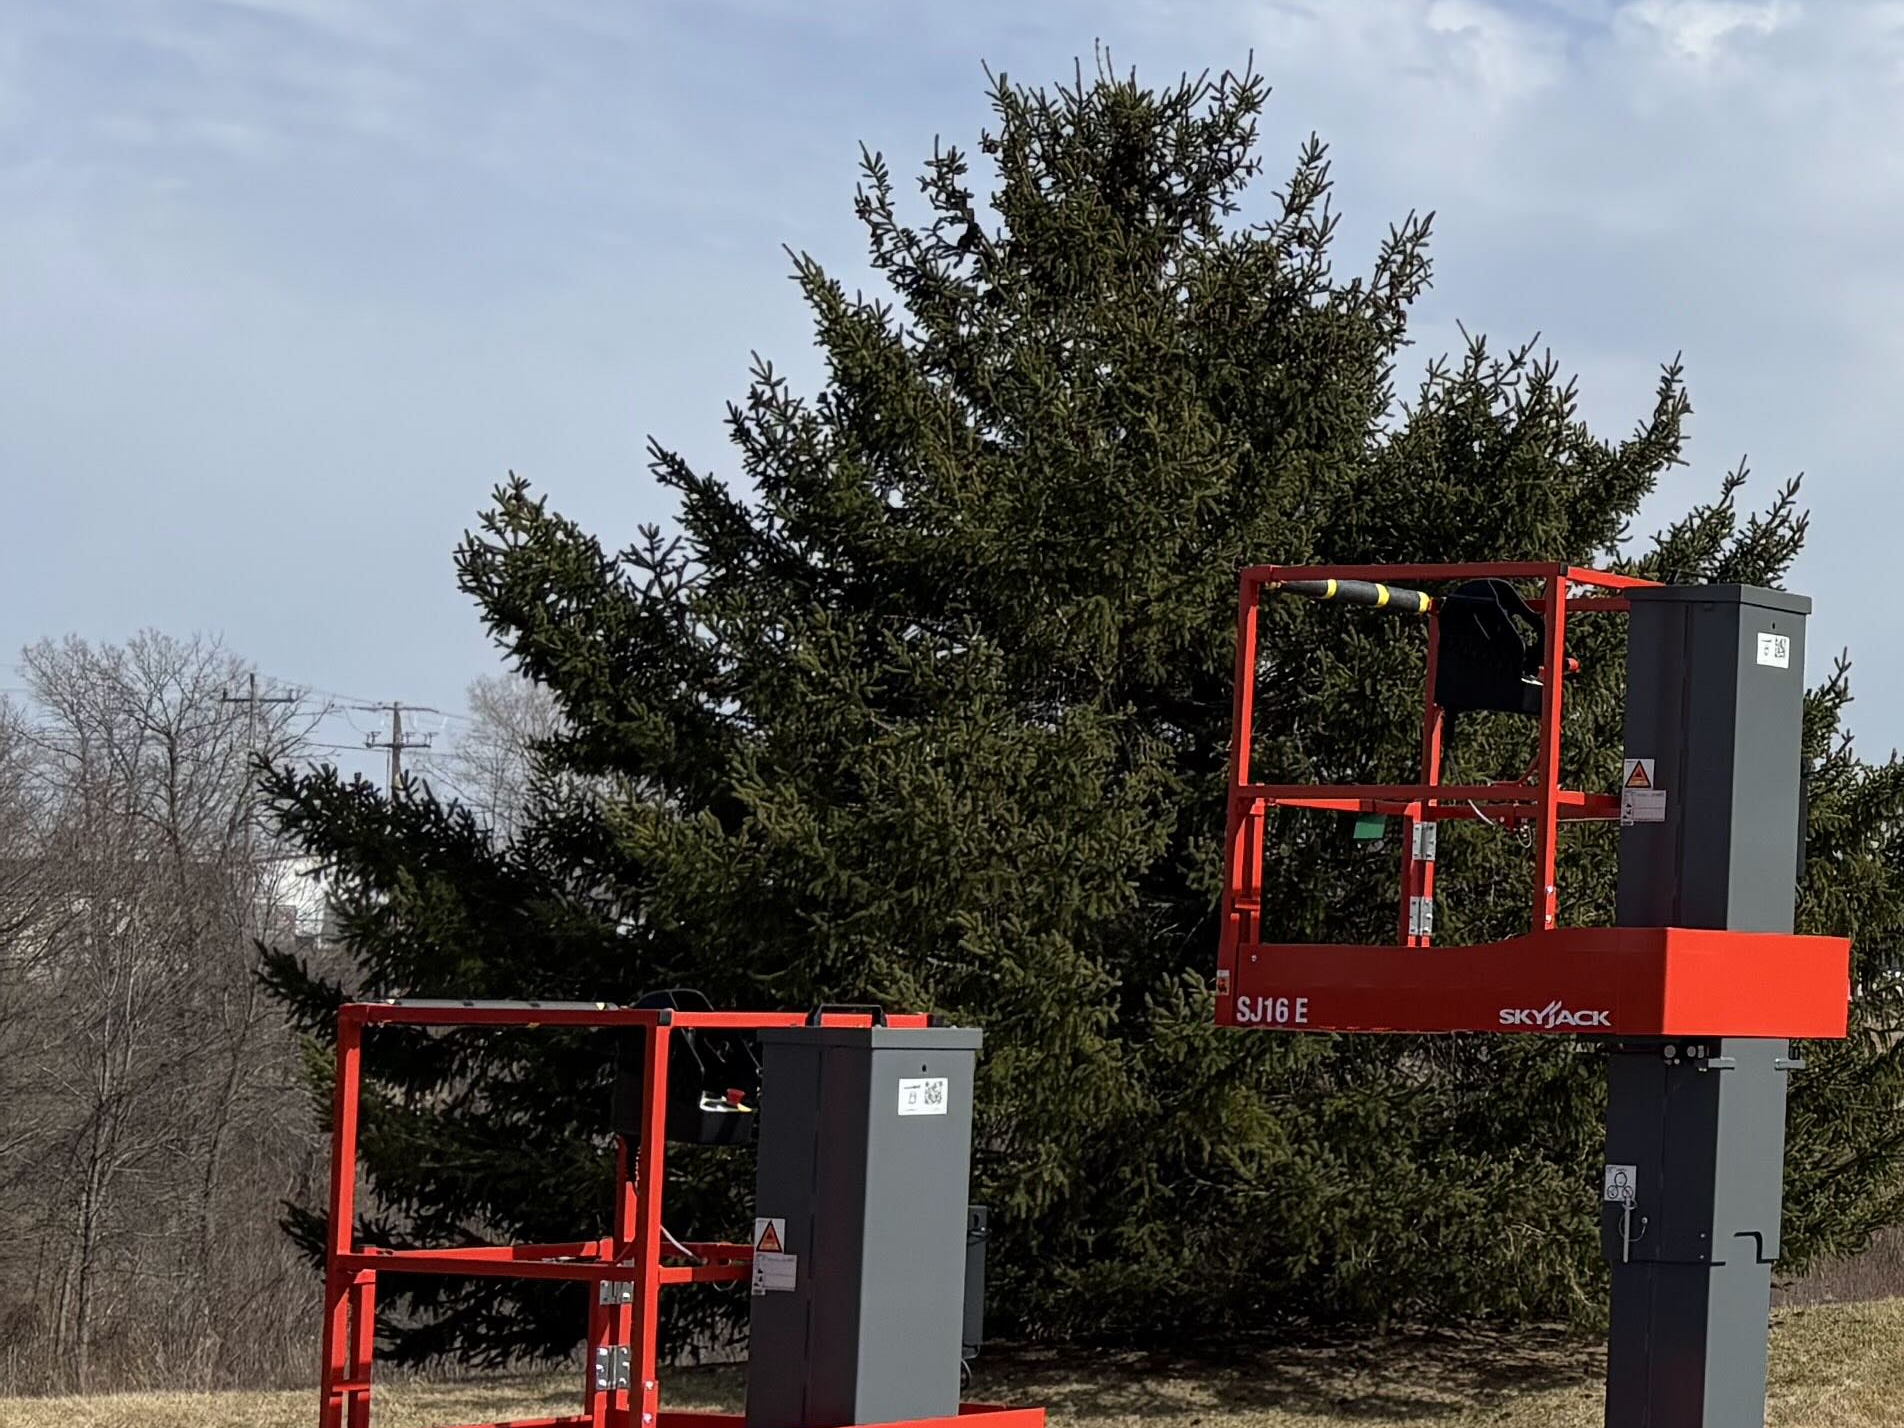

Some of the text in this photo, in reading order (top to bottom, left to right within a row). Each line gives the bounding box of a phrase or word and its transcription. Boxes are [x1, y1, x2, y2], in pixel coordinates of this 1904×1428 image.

[1236, 996, 1309, 1024] SJ16 E
[1499, 1000, 1612, 1029] SKYJACK
